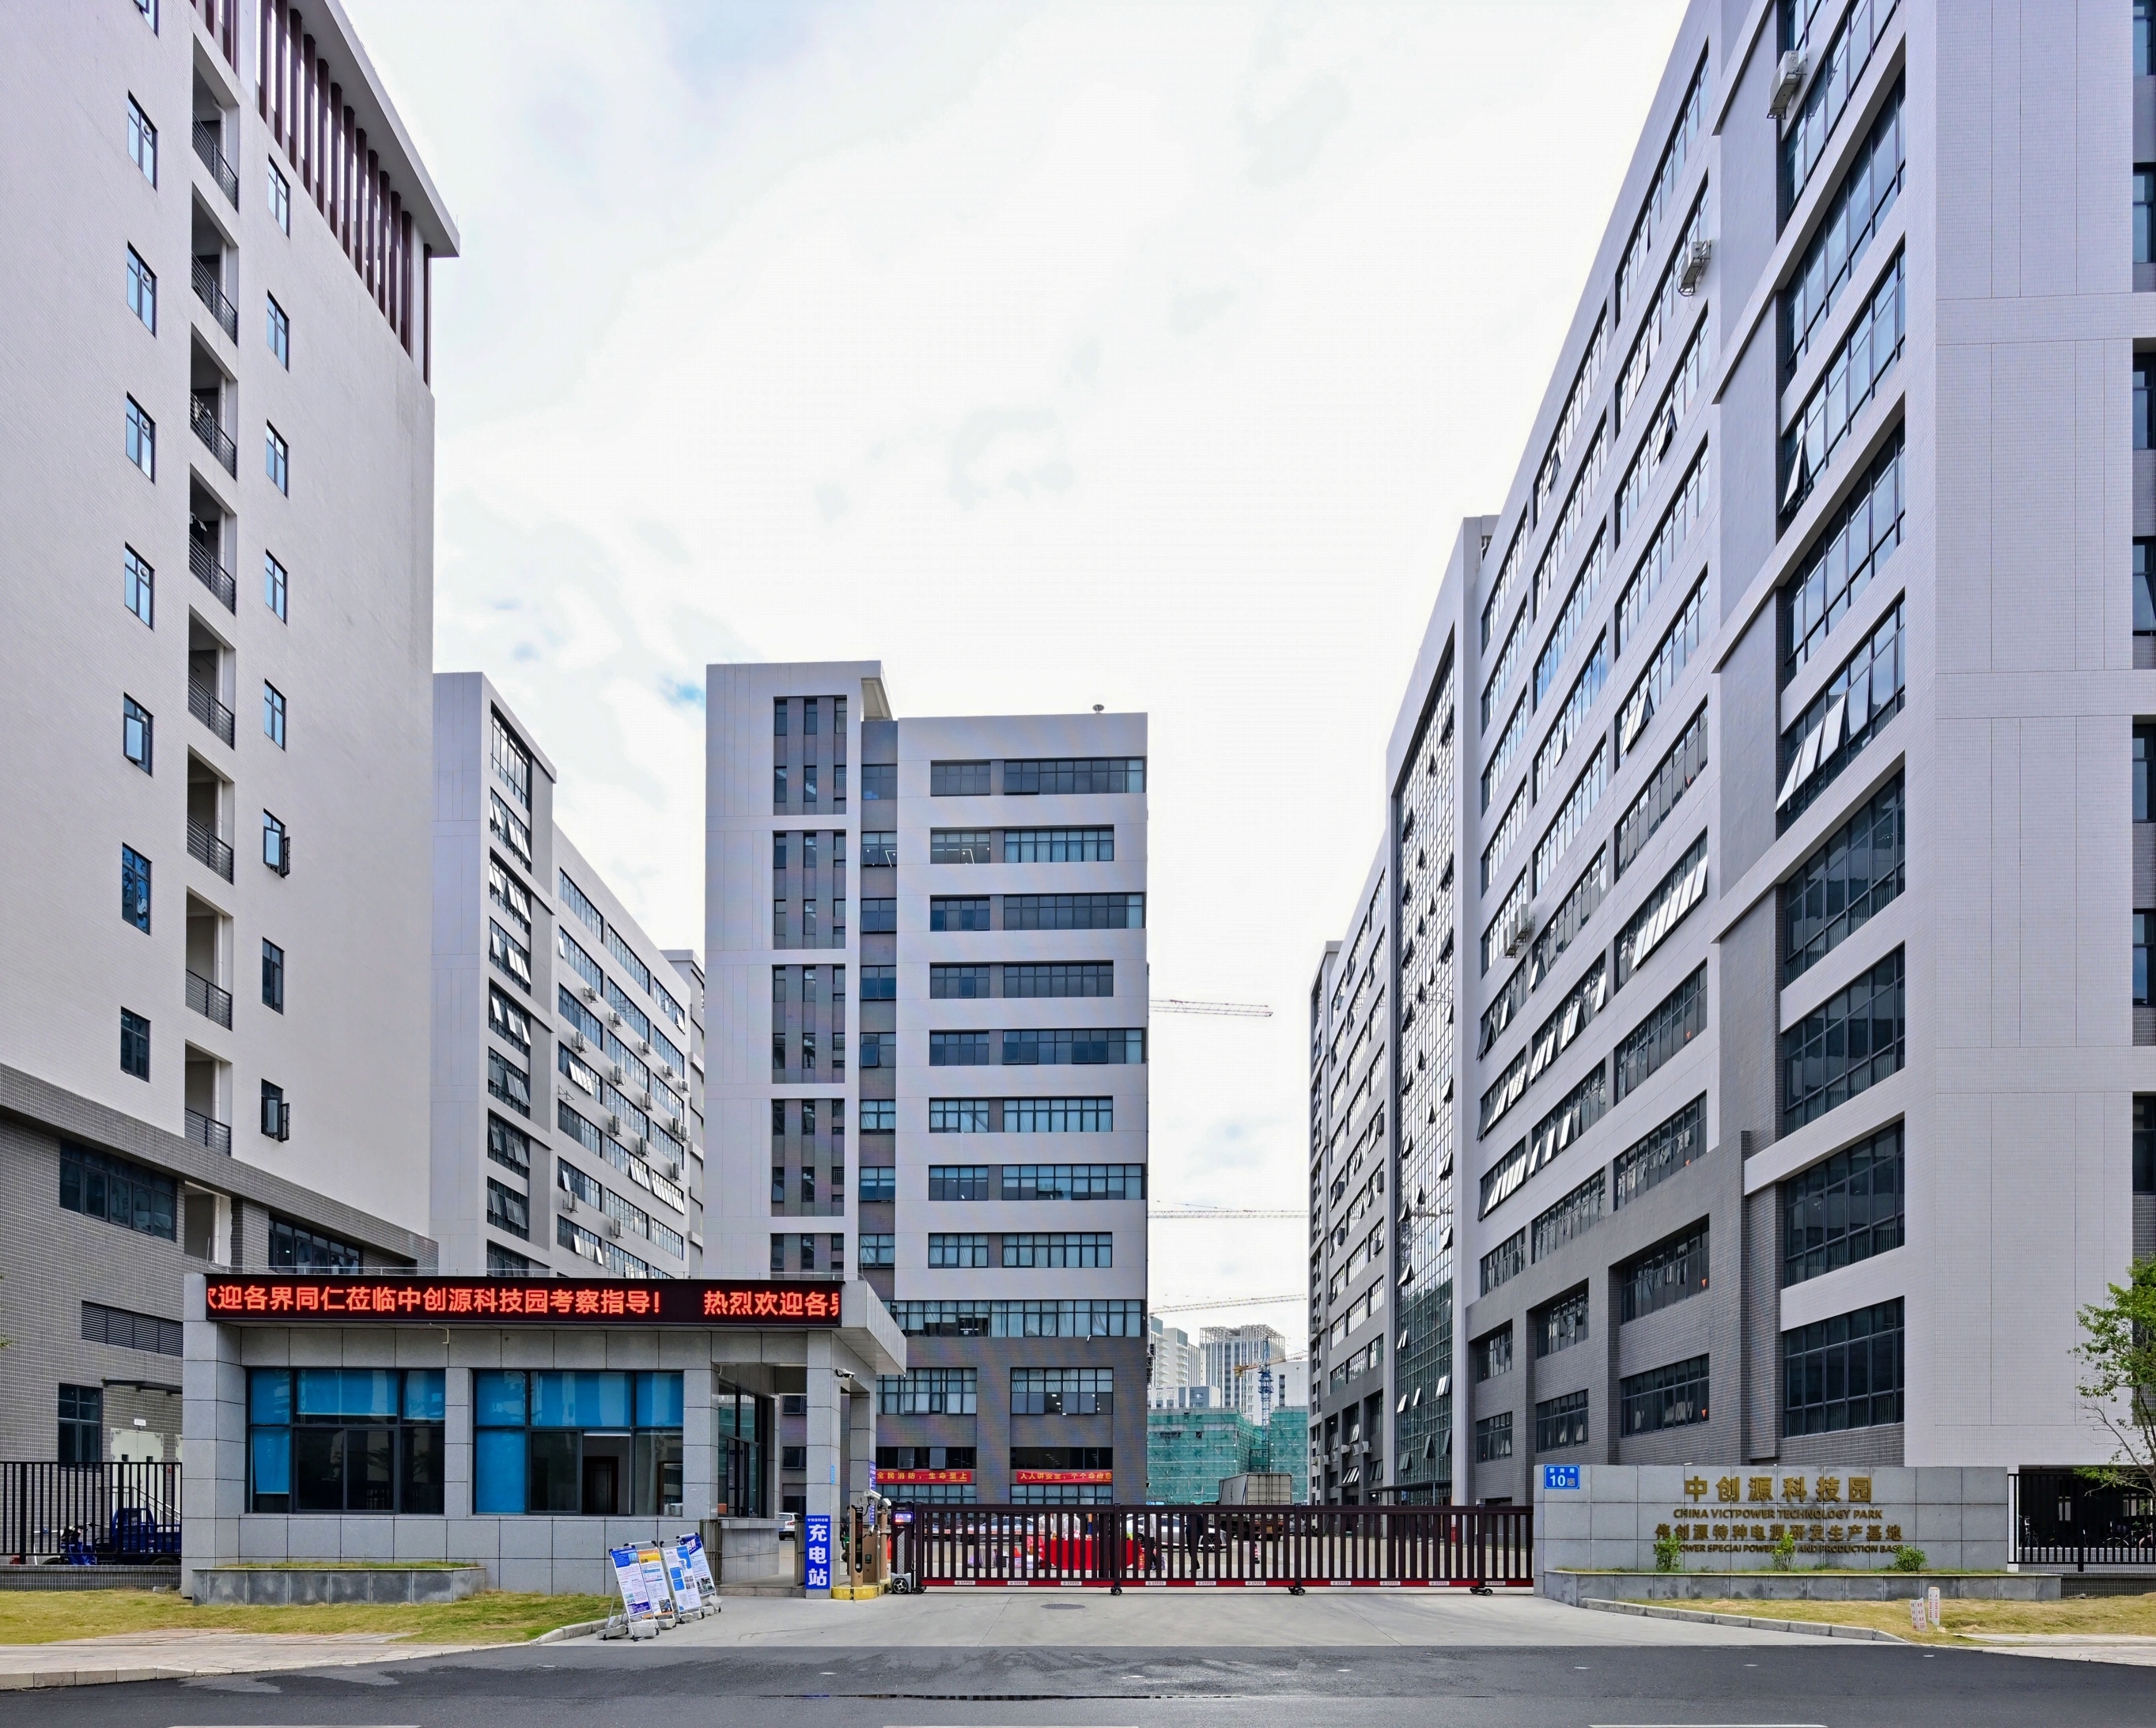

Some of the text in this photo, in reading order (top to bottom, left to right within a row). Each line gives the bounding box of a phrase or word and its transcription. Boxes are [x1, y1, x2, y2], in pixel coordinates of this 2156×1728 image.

[876, 1472, 967, 1480] 全民消防，生命至上
[1550, 1474, 1566, 1487] 10
[1685, 1476, 1871, 1502] 中创源科技园
[1674, 1509, 1883, 1519] CHINA VICTPOWER TECHNOLOGY PARK
[1655, 1523, 1902, 1541] 伟创源特种电源研发生产基地
[808, 1523, 828, 1586] 充电站
[1797, 1545, 1817, 1553] AND
[1819, 1545, 1878, 1554] PRODUCTION
